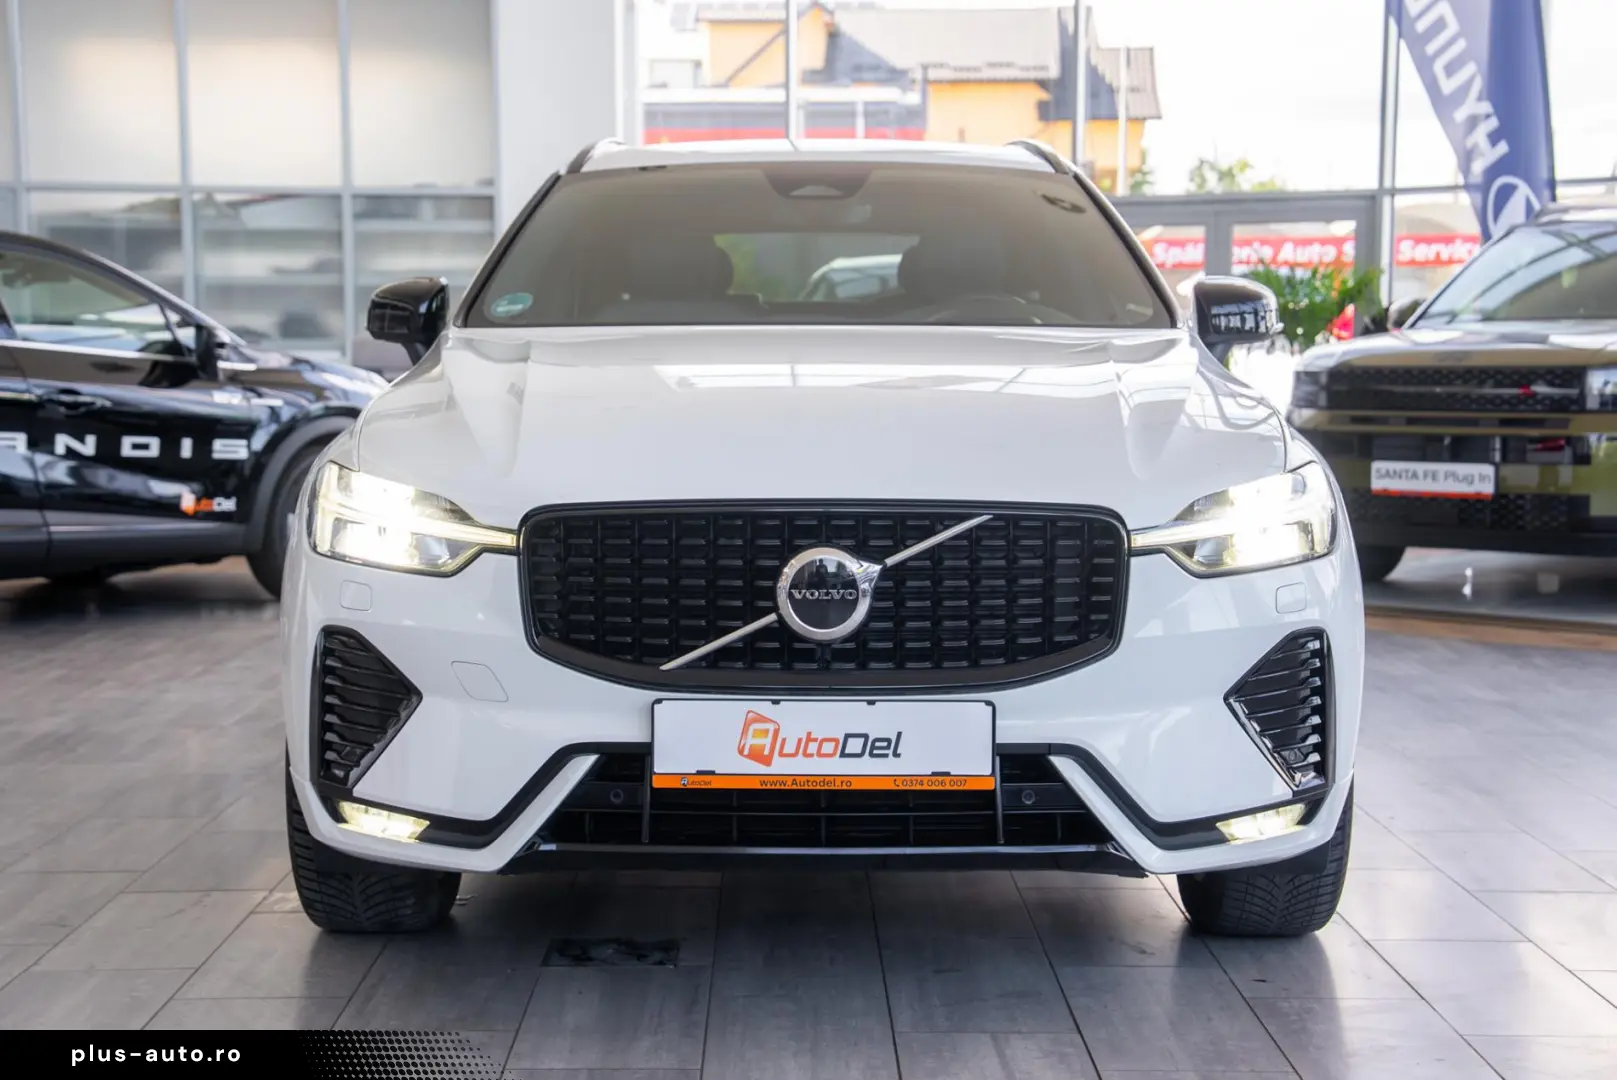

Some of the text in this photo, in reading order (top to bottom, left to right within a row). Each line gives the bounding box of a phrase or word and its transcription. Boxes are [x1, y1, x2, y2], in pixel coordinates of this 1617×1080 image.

[1403, 0, 1510, 175] HYUN
[1277, 240, 1337, 263] Auto
[1375, 467, 1491, 487] SANTA FE Plug In
[790, 589, 857, 600] VOLVO
[740, 716, 903, 762] AutoDel
[759, 778, 852, 788] www.Autodel.ro
[901, 779, 967, 788] 0374 006 007
